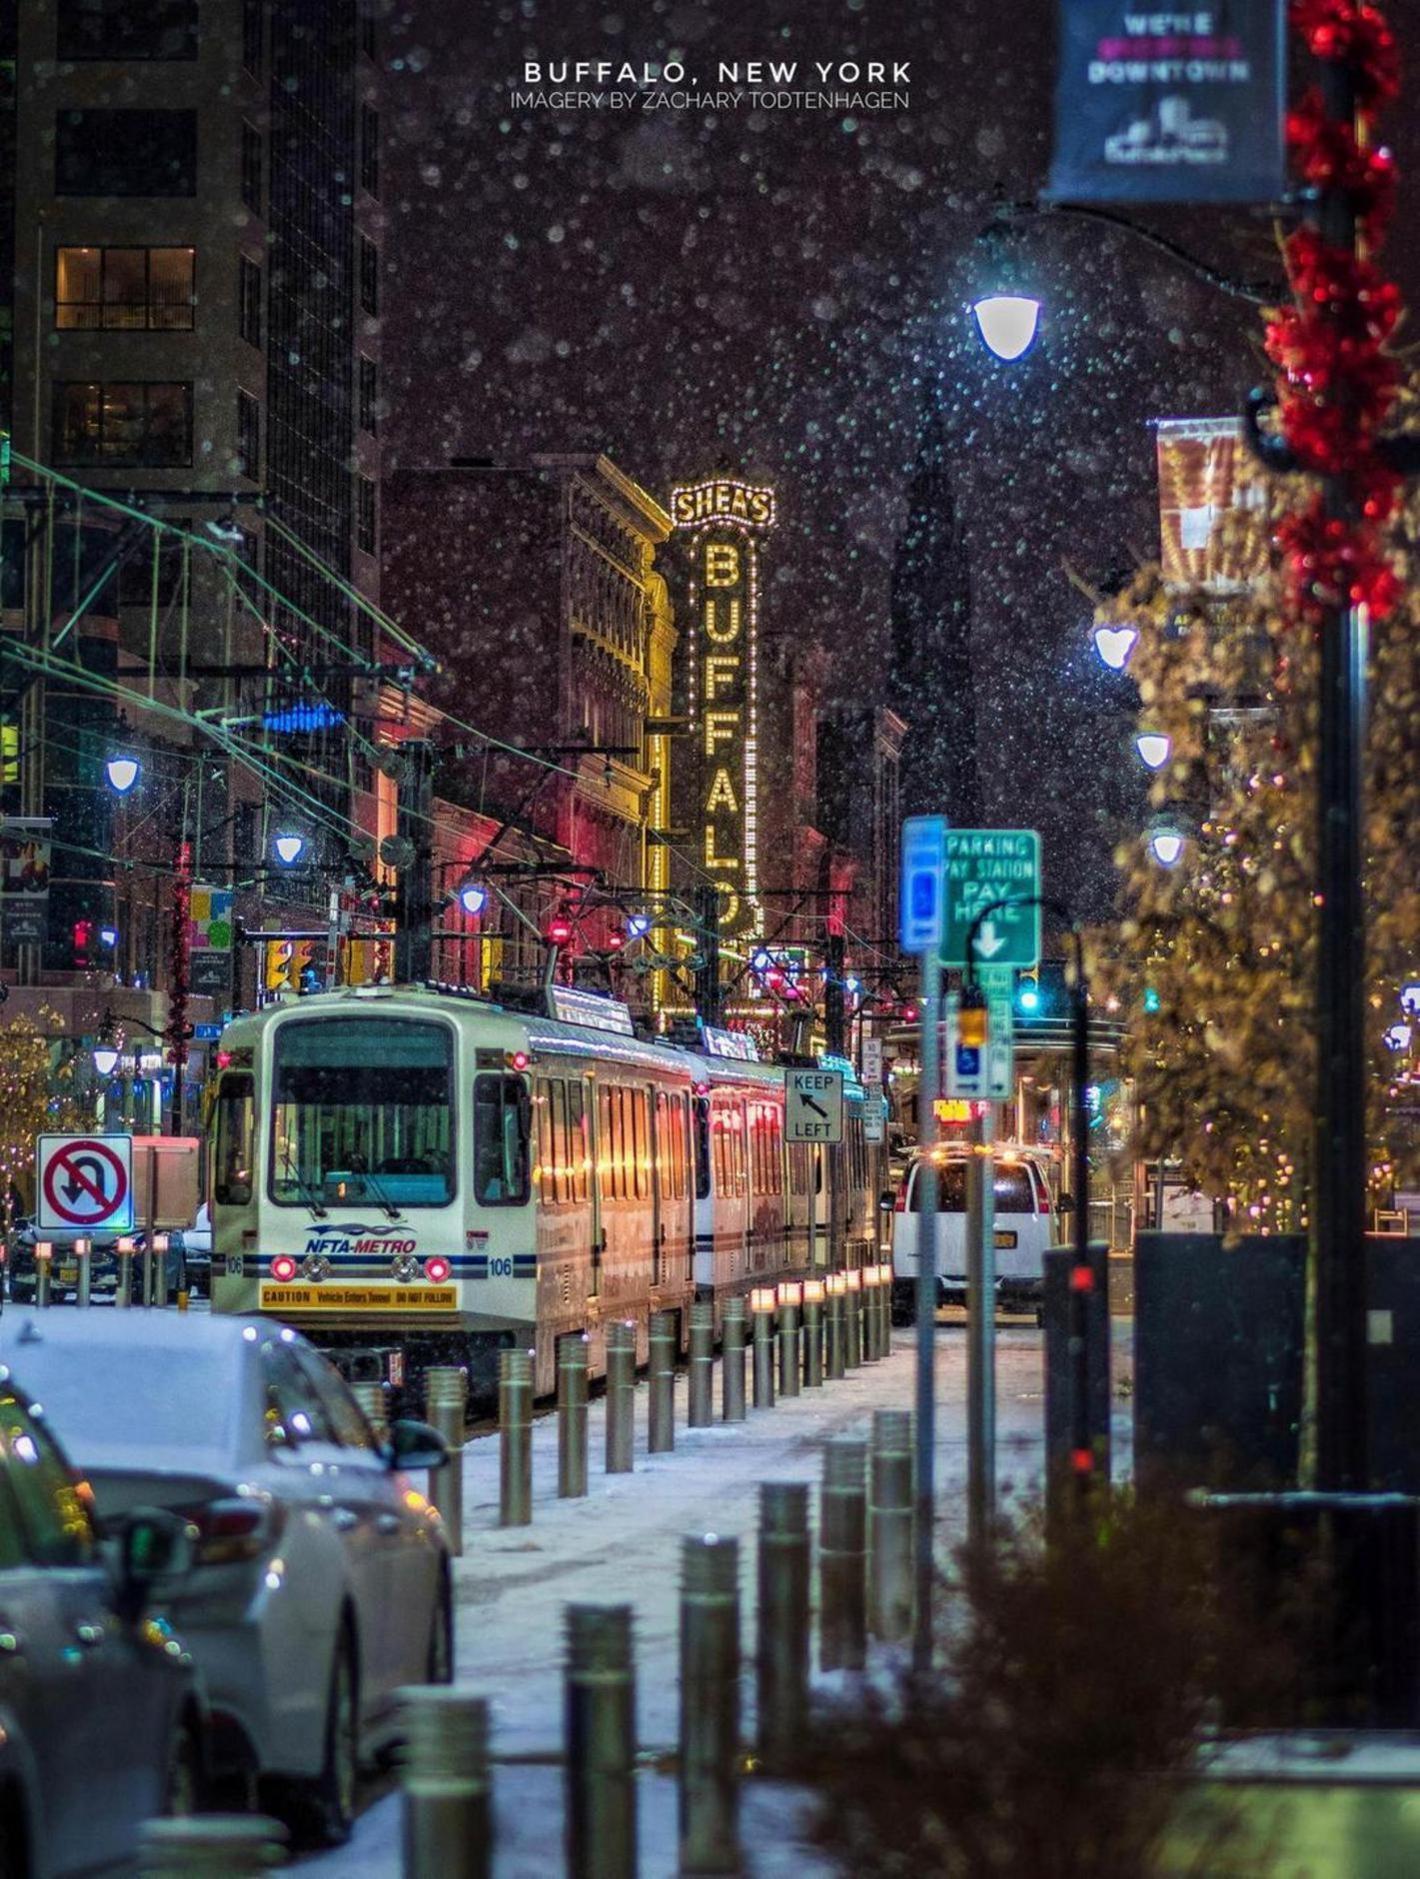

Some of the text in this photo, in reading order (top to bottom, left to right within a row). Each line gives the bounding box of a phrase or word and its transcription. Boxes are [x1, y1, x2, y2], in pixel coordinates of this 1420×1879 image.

[1087, 60, 1249, 84] DOWNTOWN
[677, 485, 769, 521] SHEA'S
[705, 544, 740, 924] BUFFALO
[946, 836, 1028, 856] PARKING
[976, 859, 1034, 879] STATION
[963, 881, 1011, 901] PAY
[794, 1076, 834, 1090] KEEP
[795, 1123, 832, 1137] LEFT
[306, 1239, 417, 1254] NFTA-METRO
[490, 1258, 512, 1276] 106
[263, 1291, 310, 1302] CAUTION
